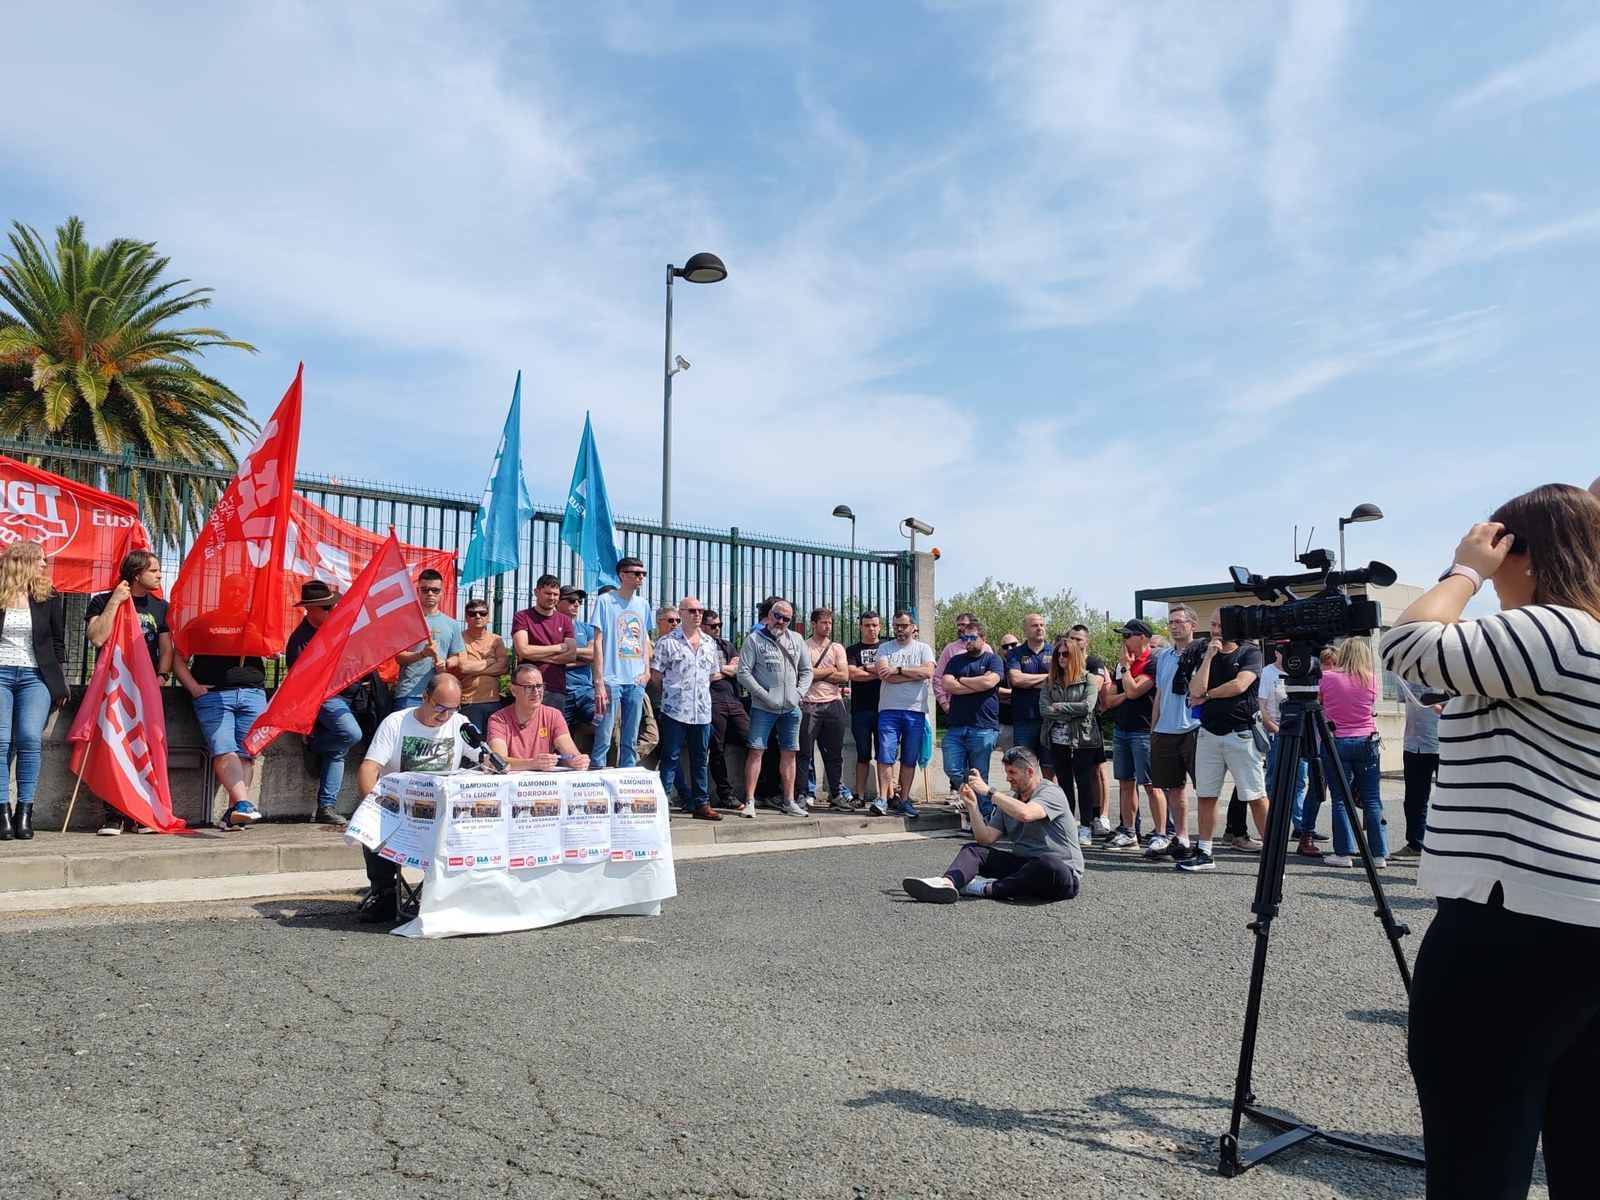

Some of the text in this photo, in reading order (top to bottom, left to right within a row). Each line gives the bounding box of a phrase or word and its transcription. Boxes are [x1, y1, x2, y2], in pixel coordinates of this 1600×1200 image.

[0, 480, 62, 523] GT
[416, 742, 444, 756] NIKE
[517, 789, 559, 798] BORROKAN
